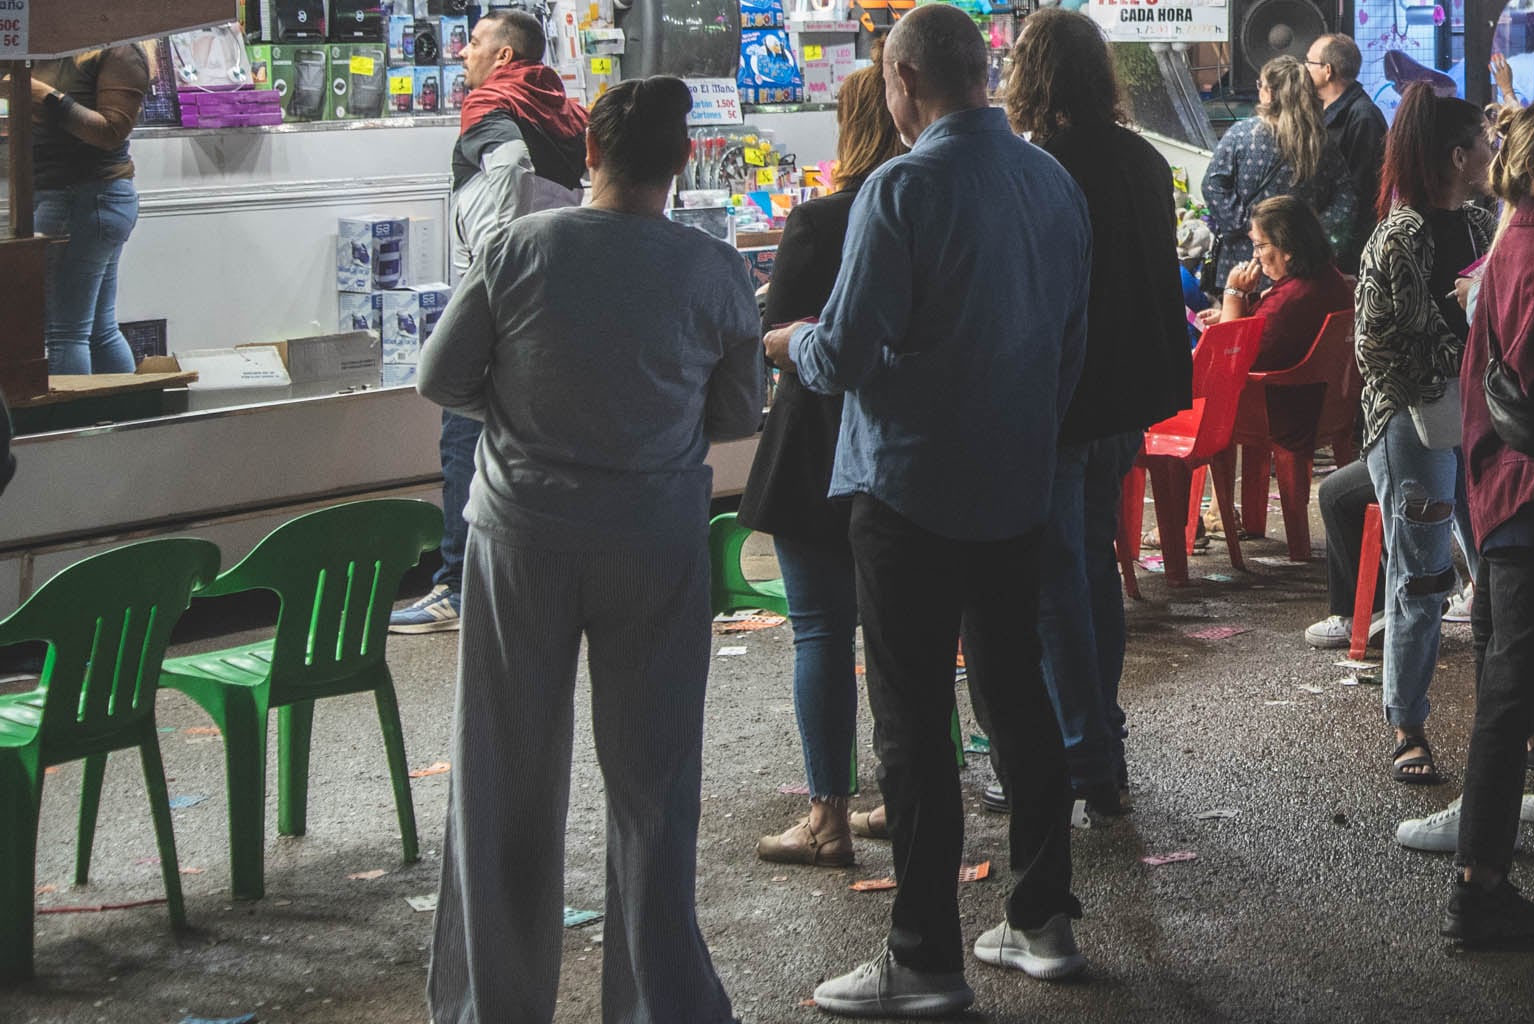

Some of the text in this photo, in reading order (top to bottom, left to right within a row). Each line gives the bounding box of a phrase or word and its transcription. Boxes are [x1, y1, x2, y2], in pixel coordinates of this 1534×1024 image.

[1120, 8, 1193, 22] CADA HORA
[0, 19, 20, 32] 50€
[4, 35, 20, 47] 5€
[716, 99, 735, 108] 1.50€
[691, 110, 737, 120] Cartones 5€
